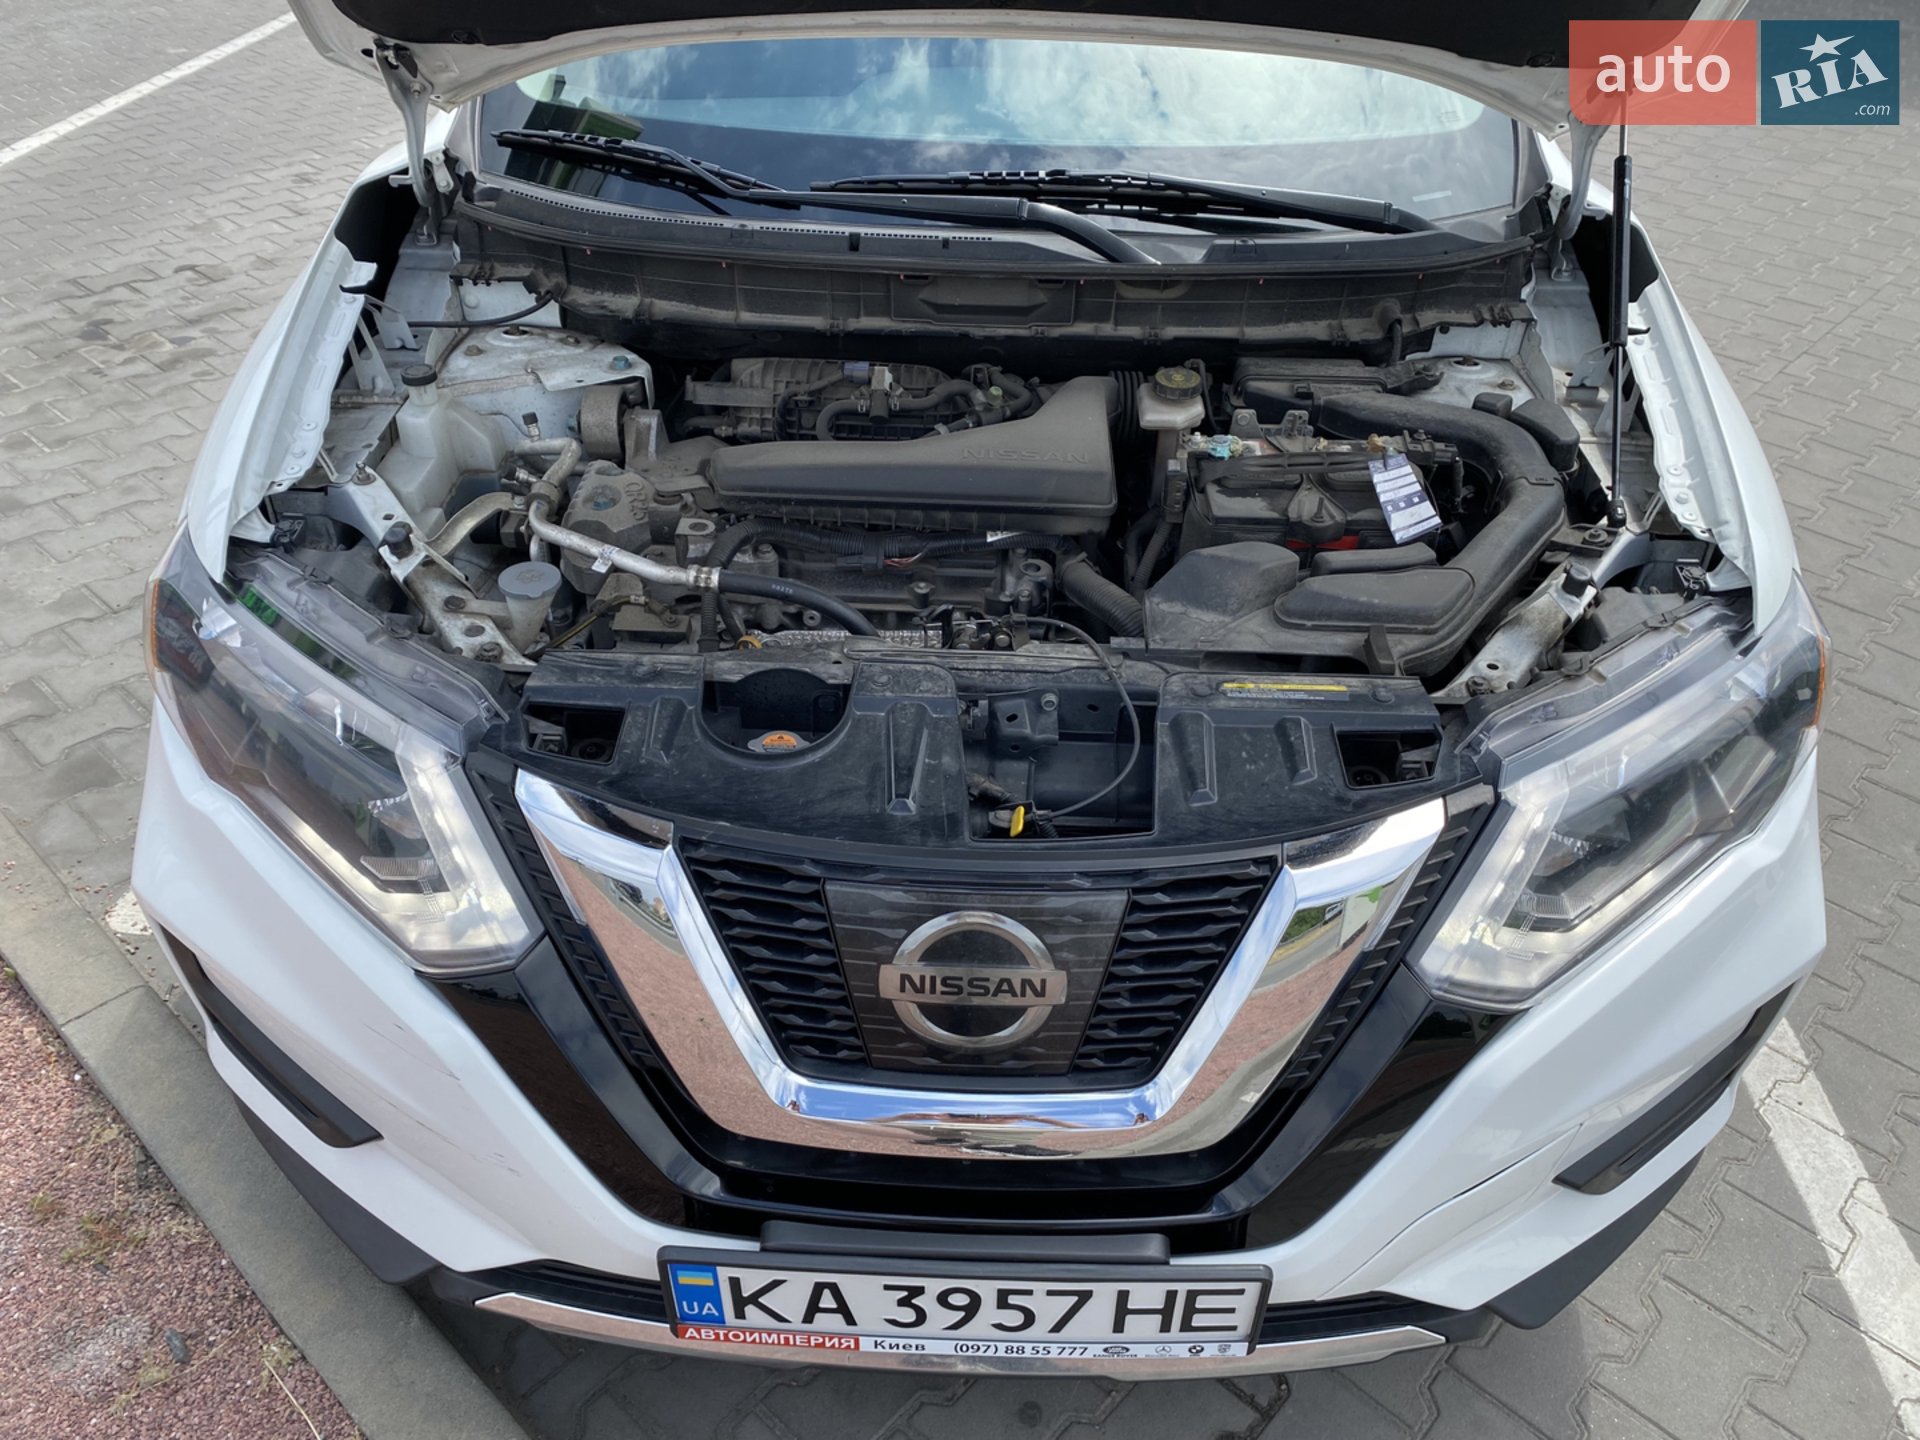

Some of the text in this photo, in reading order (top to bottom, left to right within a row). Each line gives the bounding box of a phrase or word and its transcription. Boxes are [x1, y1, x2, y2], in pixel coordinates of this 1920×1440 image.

[962, 447, 1089, 464] NISSAN
[899, 973, 1047, 998] NISSAN
[682, 1300, 719, 1316] UA
[727, 1275, 1246, 1334] KA 3957 HE
[684, 1327, 1089, 1357] АВТОИМПЕРИЯ Киев (097) 88 55 777
